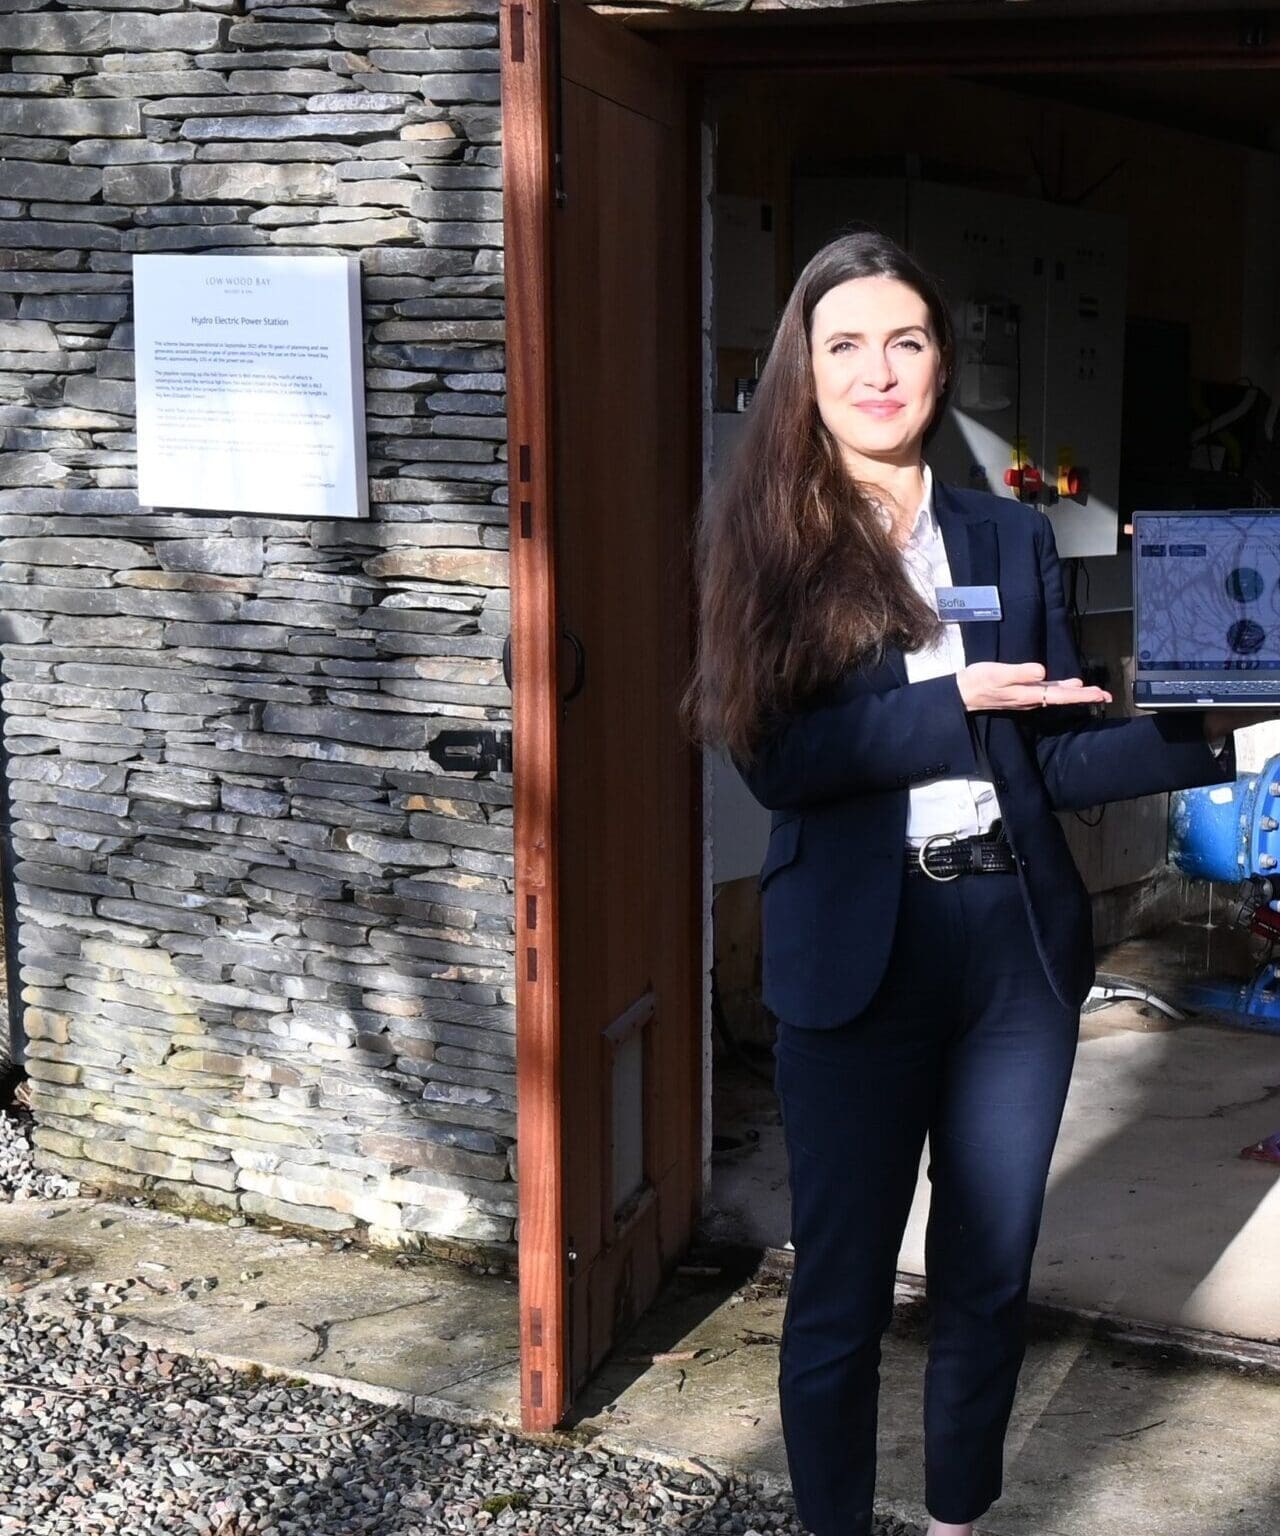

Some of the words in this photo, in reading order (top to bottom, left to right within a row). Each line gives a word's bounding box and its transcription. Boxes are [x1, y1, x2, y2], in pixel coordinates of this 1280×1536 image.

[205, 277, 223, 286] LOW
[225, 277, 253, 286] WOOD
[256, 277, 271, 286] BAY
[191, 316, 213, 326] Hydro
[214, 316, 239, 326] Electric
[241, 316, 261, 325] Power
[263, 317, 289, 326] Station
[939, 598, 966, 608] Sofia
